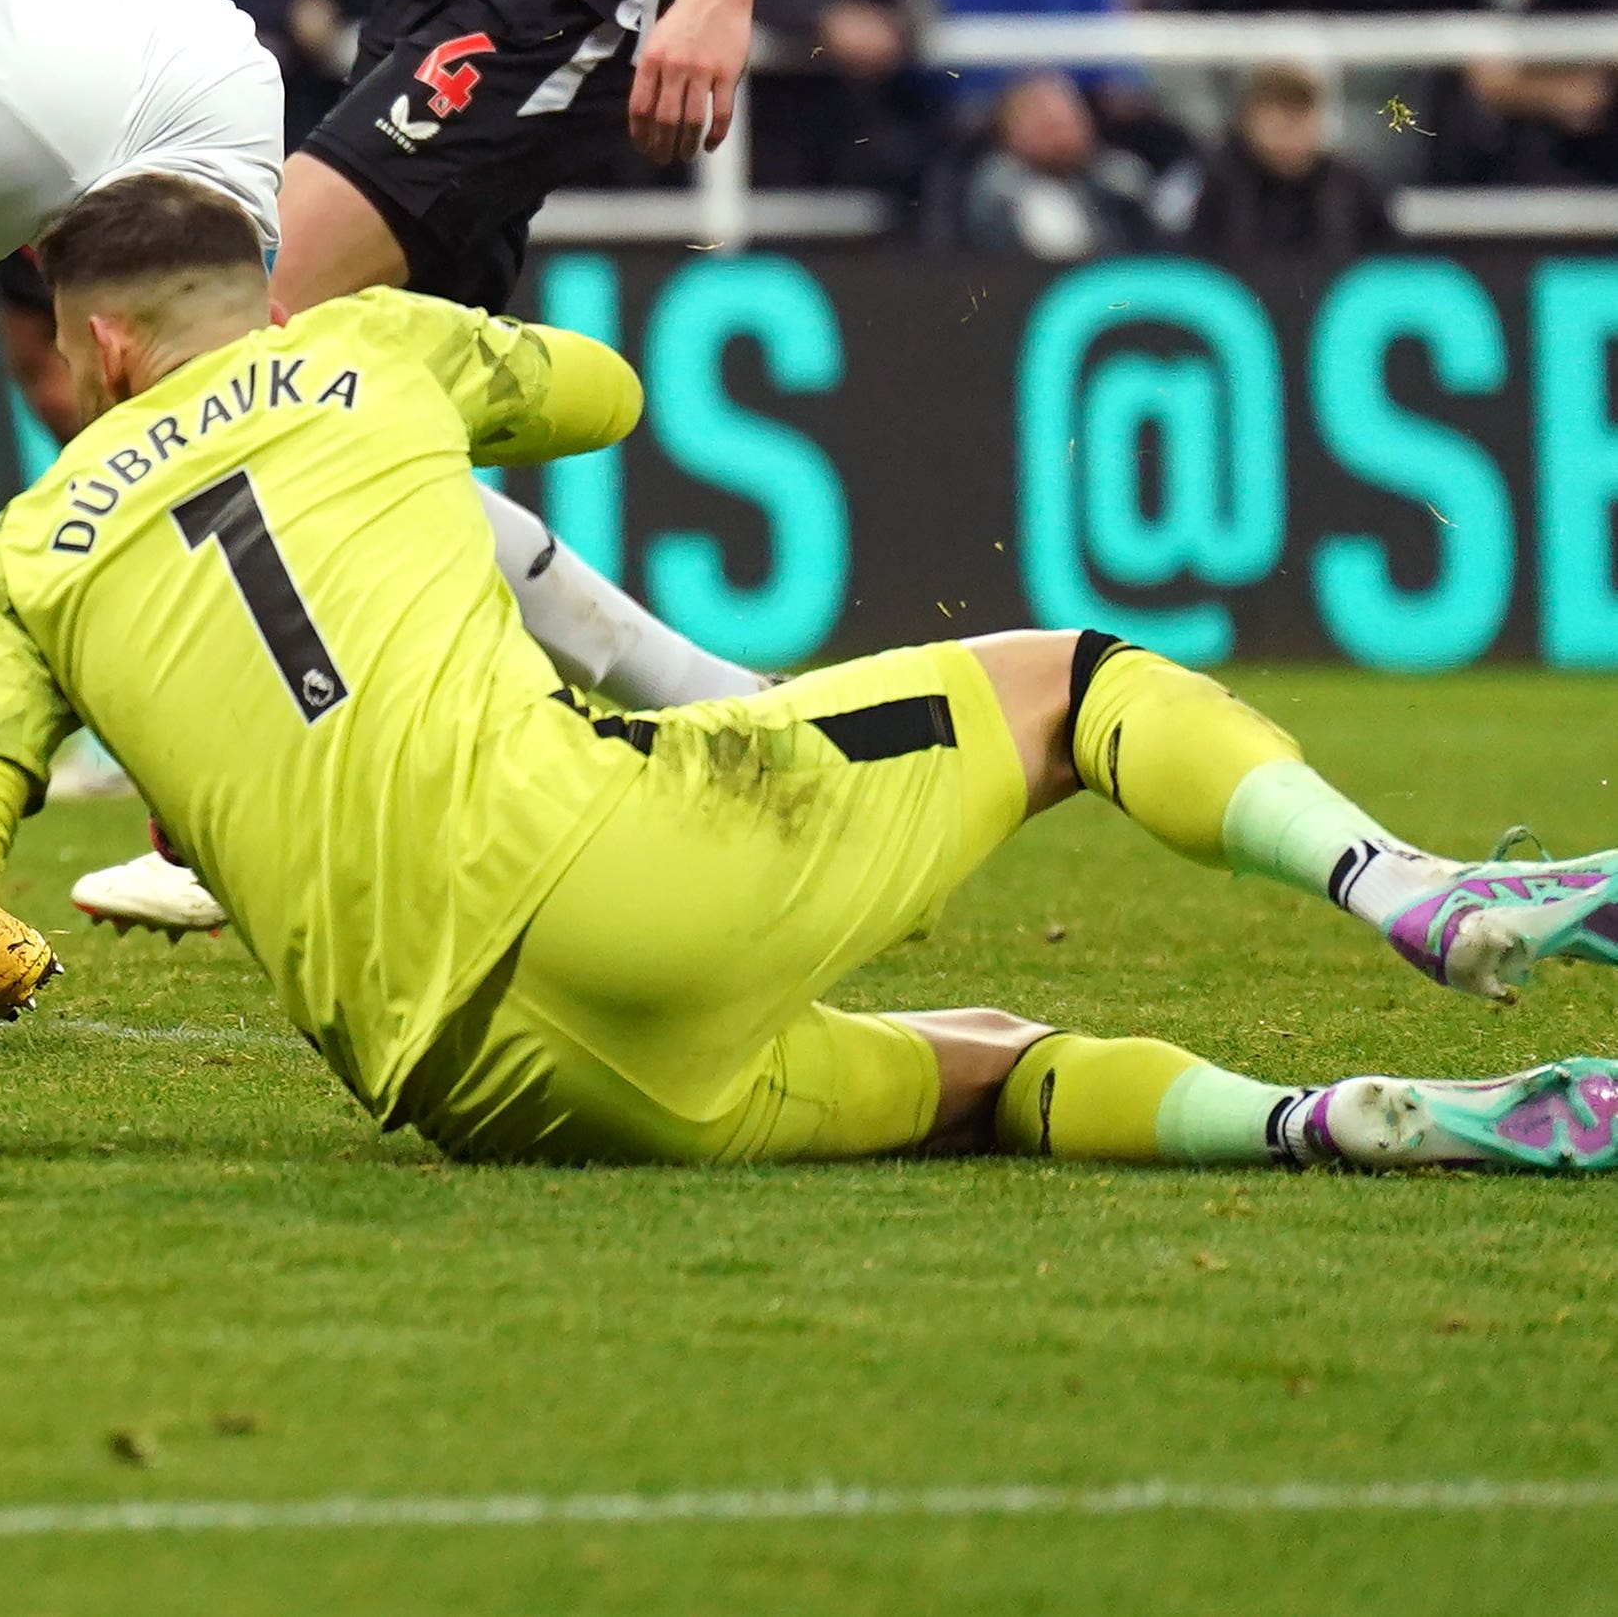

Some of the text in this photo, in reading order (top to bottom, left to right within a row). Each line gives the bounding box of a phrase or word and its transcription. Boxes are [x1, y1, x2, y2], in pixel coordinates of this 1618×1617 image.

[414, 32, 497, 118] 4
[52, 359, 361, 555] DÚBRAVKA
[169, 469, 350, 725] 1
